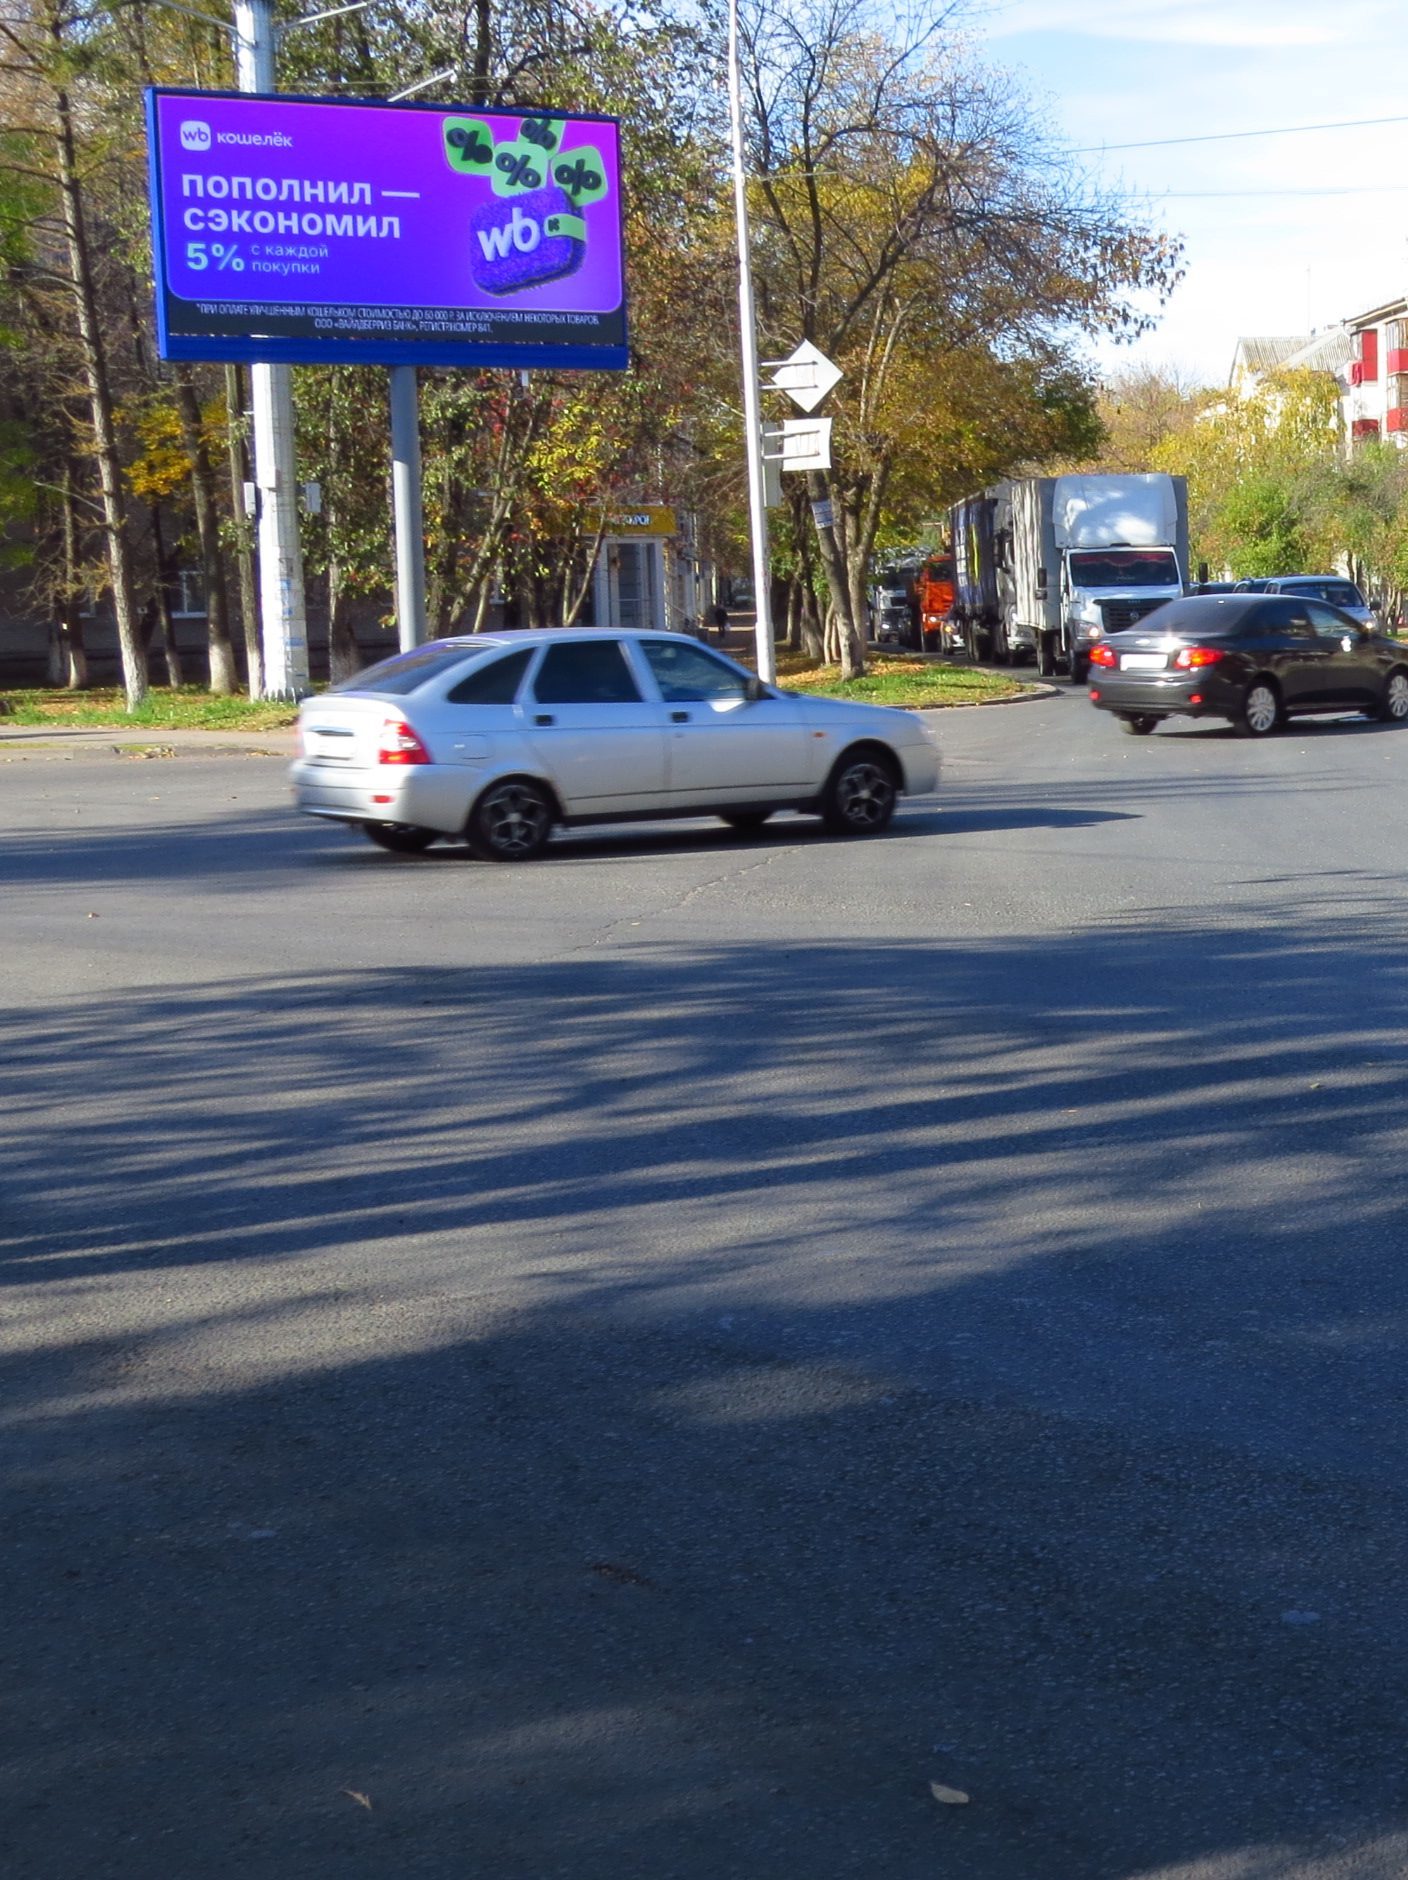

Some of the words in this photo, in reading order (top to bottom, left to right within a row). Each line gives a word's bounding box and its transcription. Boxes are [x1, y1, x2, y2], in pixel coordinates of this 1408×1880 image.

[182, 126, 209, 143] wb
[217, 131, 293, 147] кошелёк
[477, 207, 540, 261] wb
[186, 241, 245, 271] 5%
[265, 243, 328, 258] каждой
[252, 261, 320, 276] покупки
